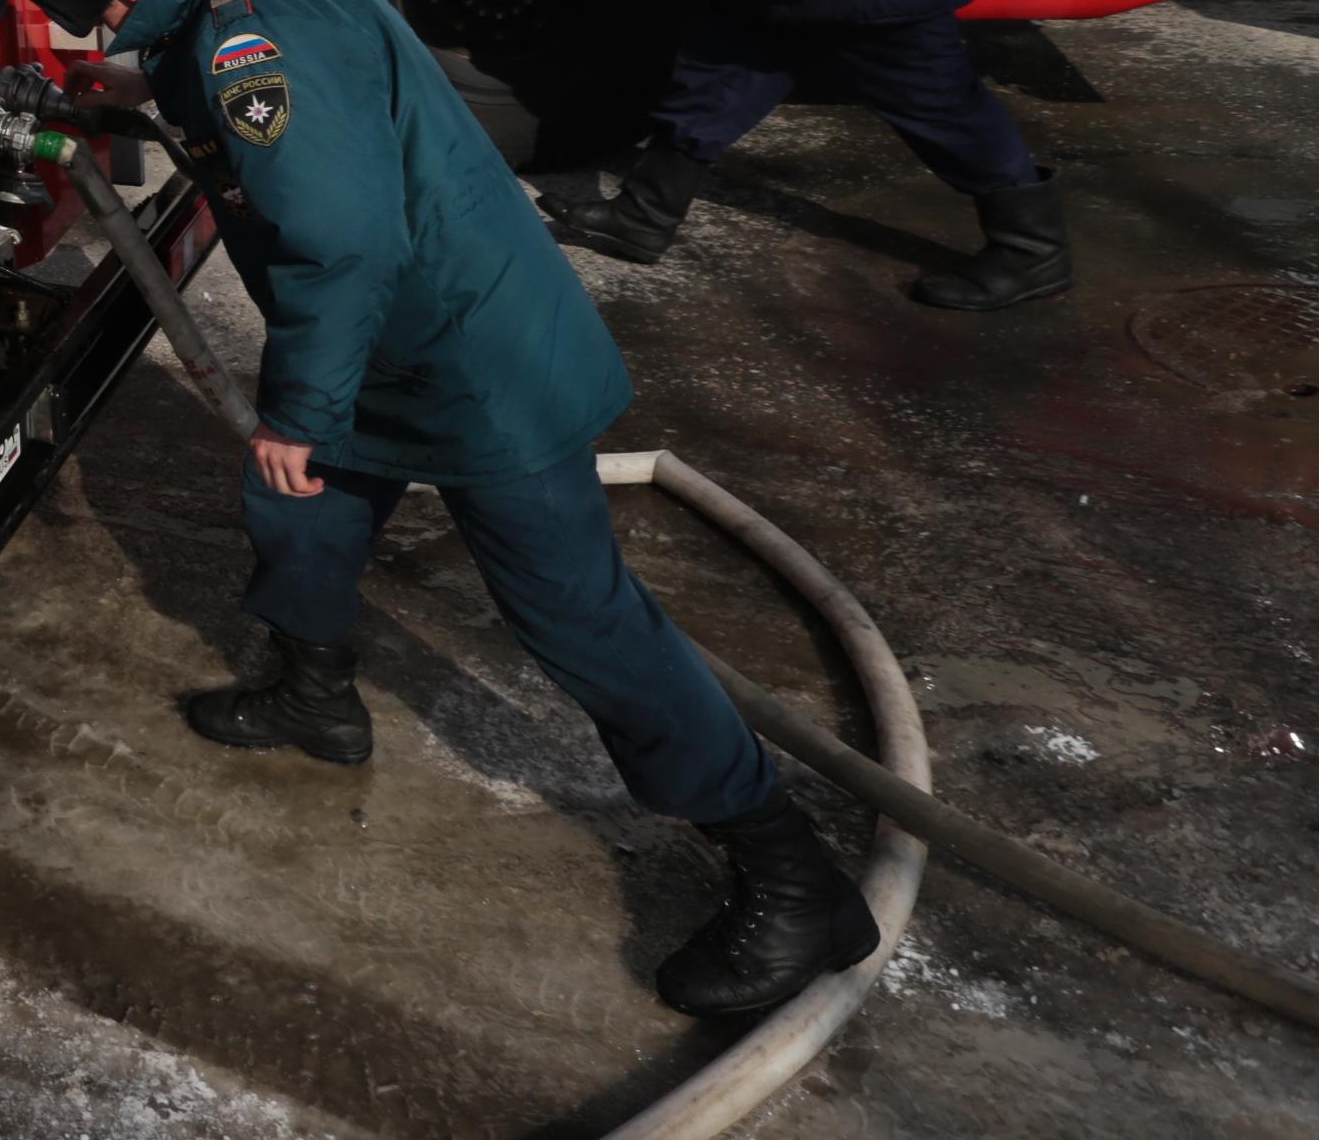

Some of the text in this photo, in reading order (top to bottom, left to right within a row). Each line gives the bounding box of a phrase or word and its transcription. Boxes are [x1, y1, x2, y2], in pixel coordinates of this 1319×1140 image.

[223, 51, 266, 69] RUSSIA
[223, 76, 283, 100] МЧС РОССИИ
